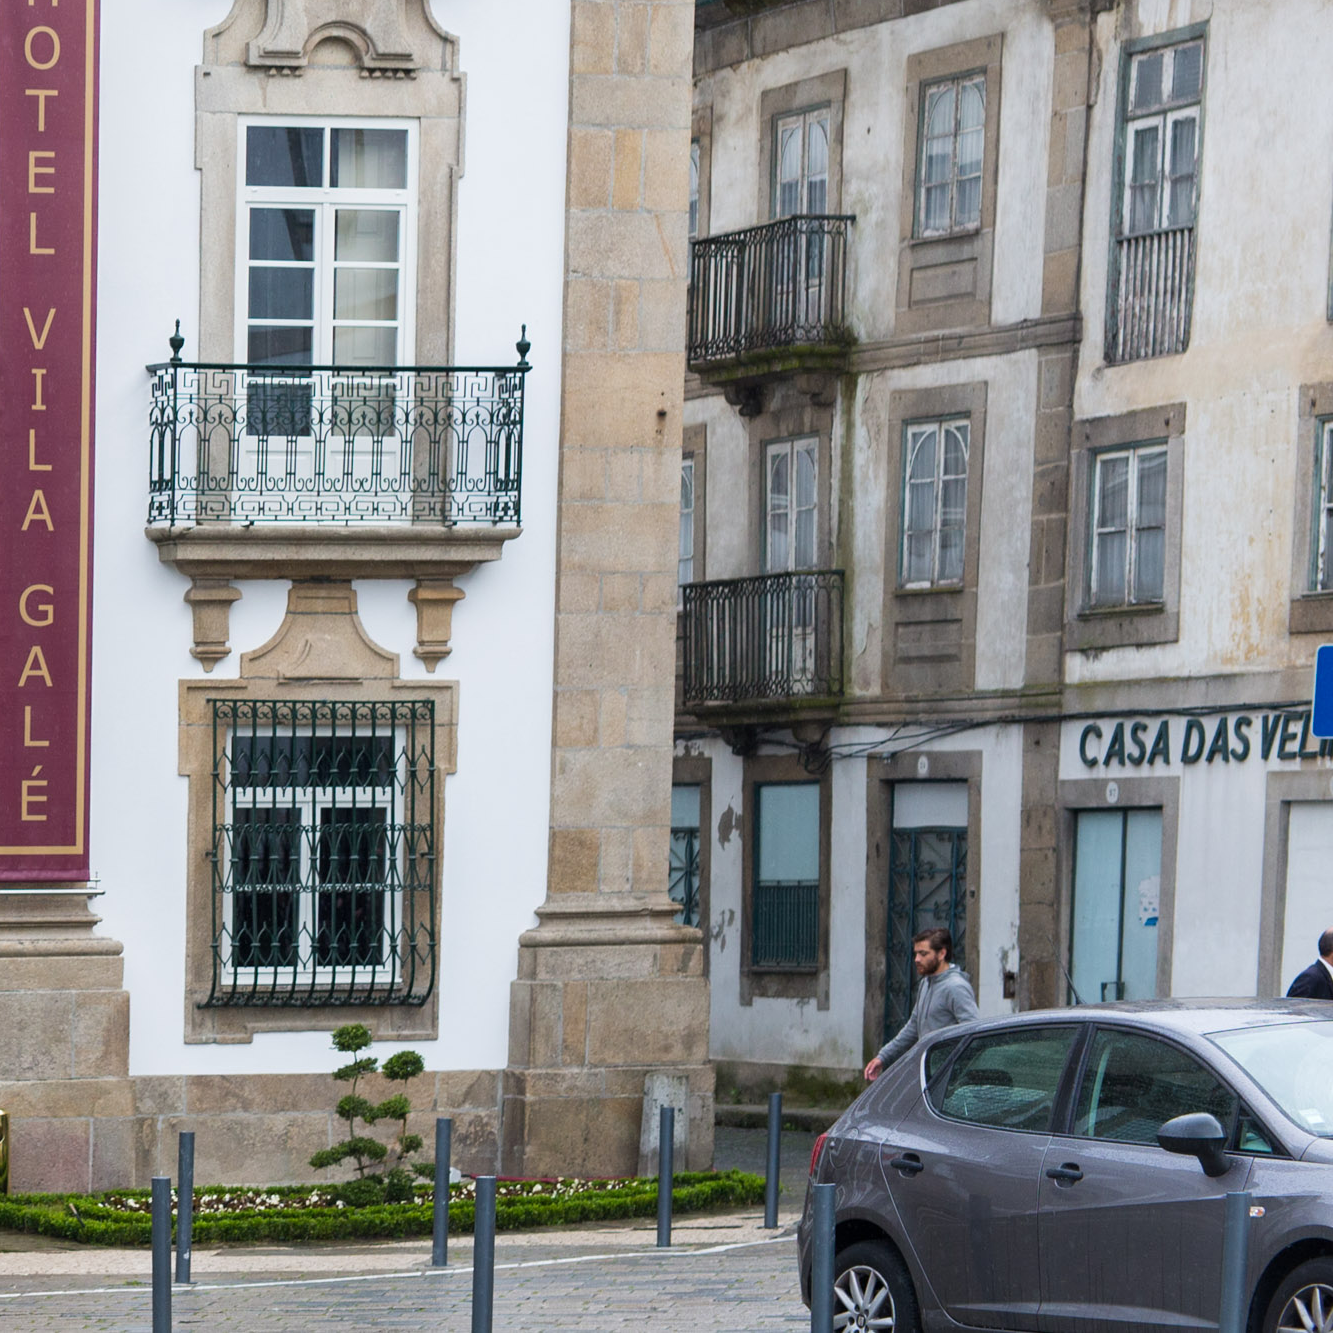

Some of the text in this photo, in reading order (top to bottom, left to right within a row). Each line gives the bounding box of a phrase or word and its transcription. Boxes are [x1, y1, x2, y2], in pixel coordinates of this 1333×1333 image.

[22, 307, 57, 531] VILA
[18, 584, 54, 821] GALÉ
[1079, 719, 1171, 768] CASA
[1181, 716, 1253, 764] DAS
